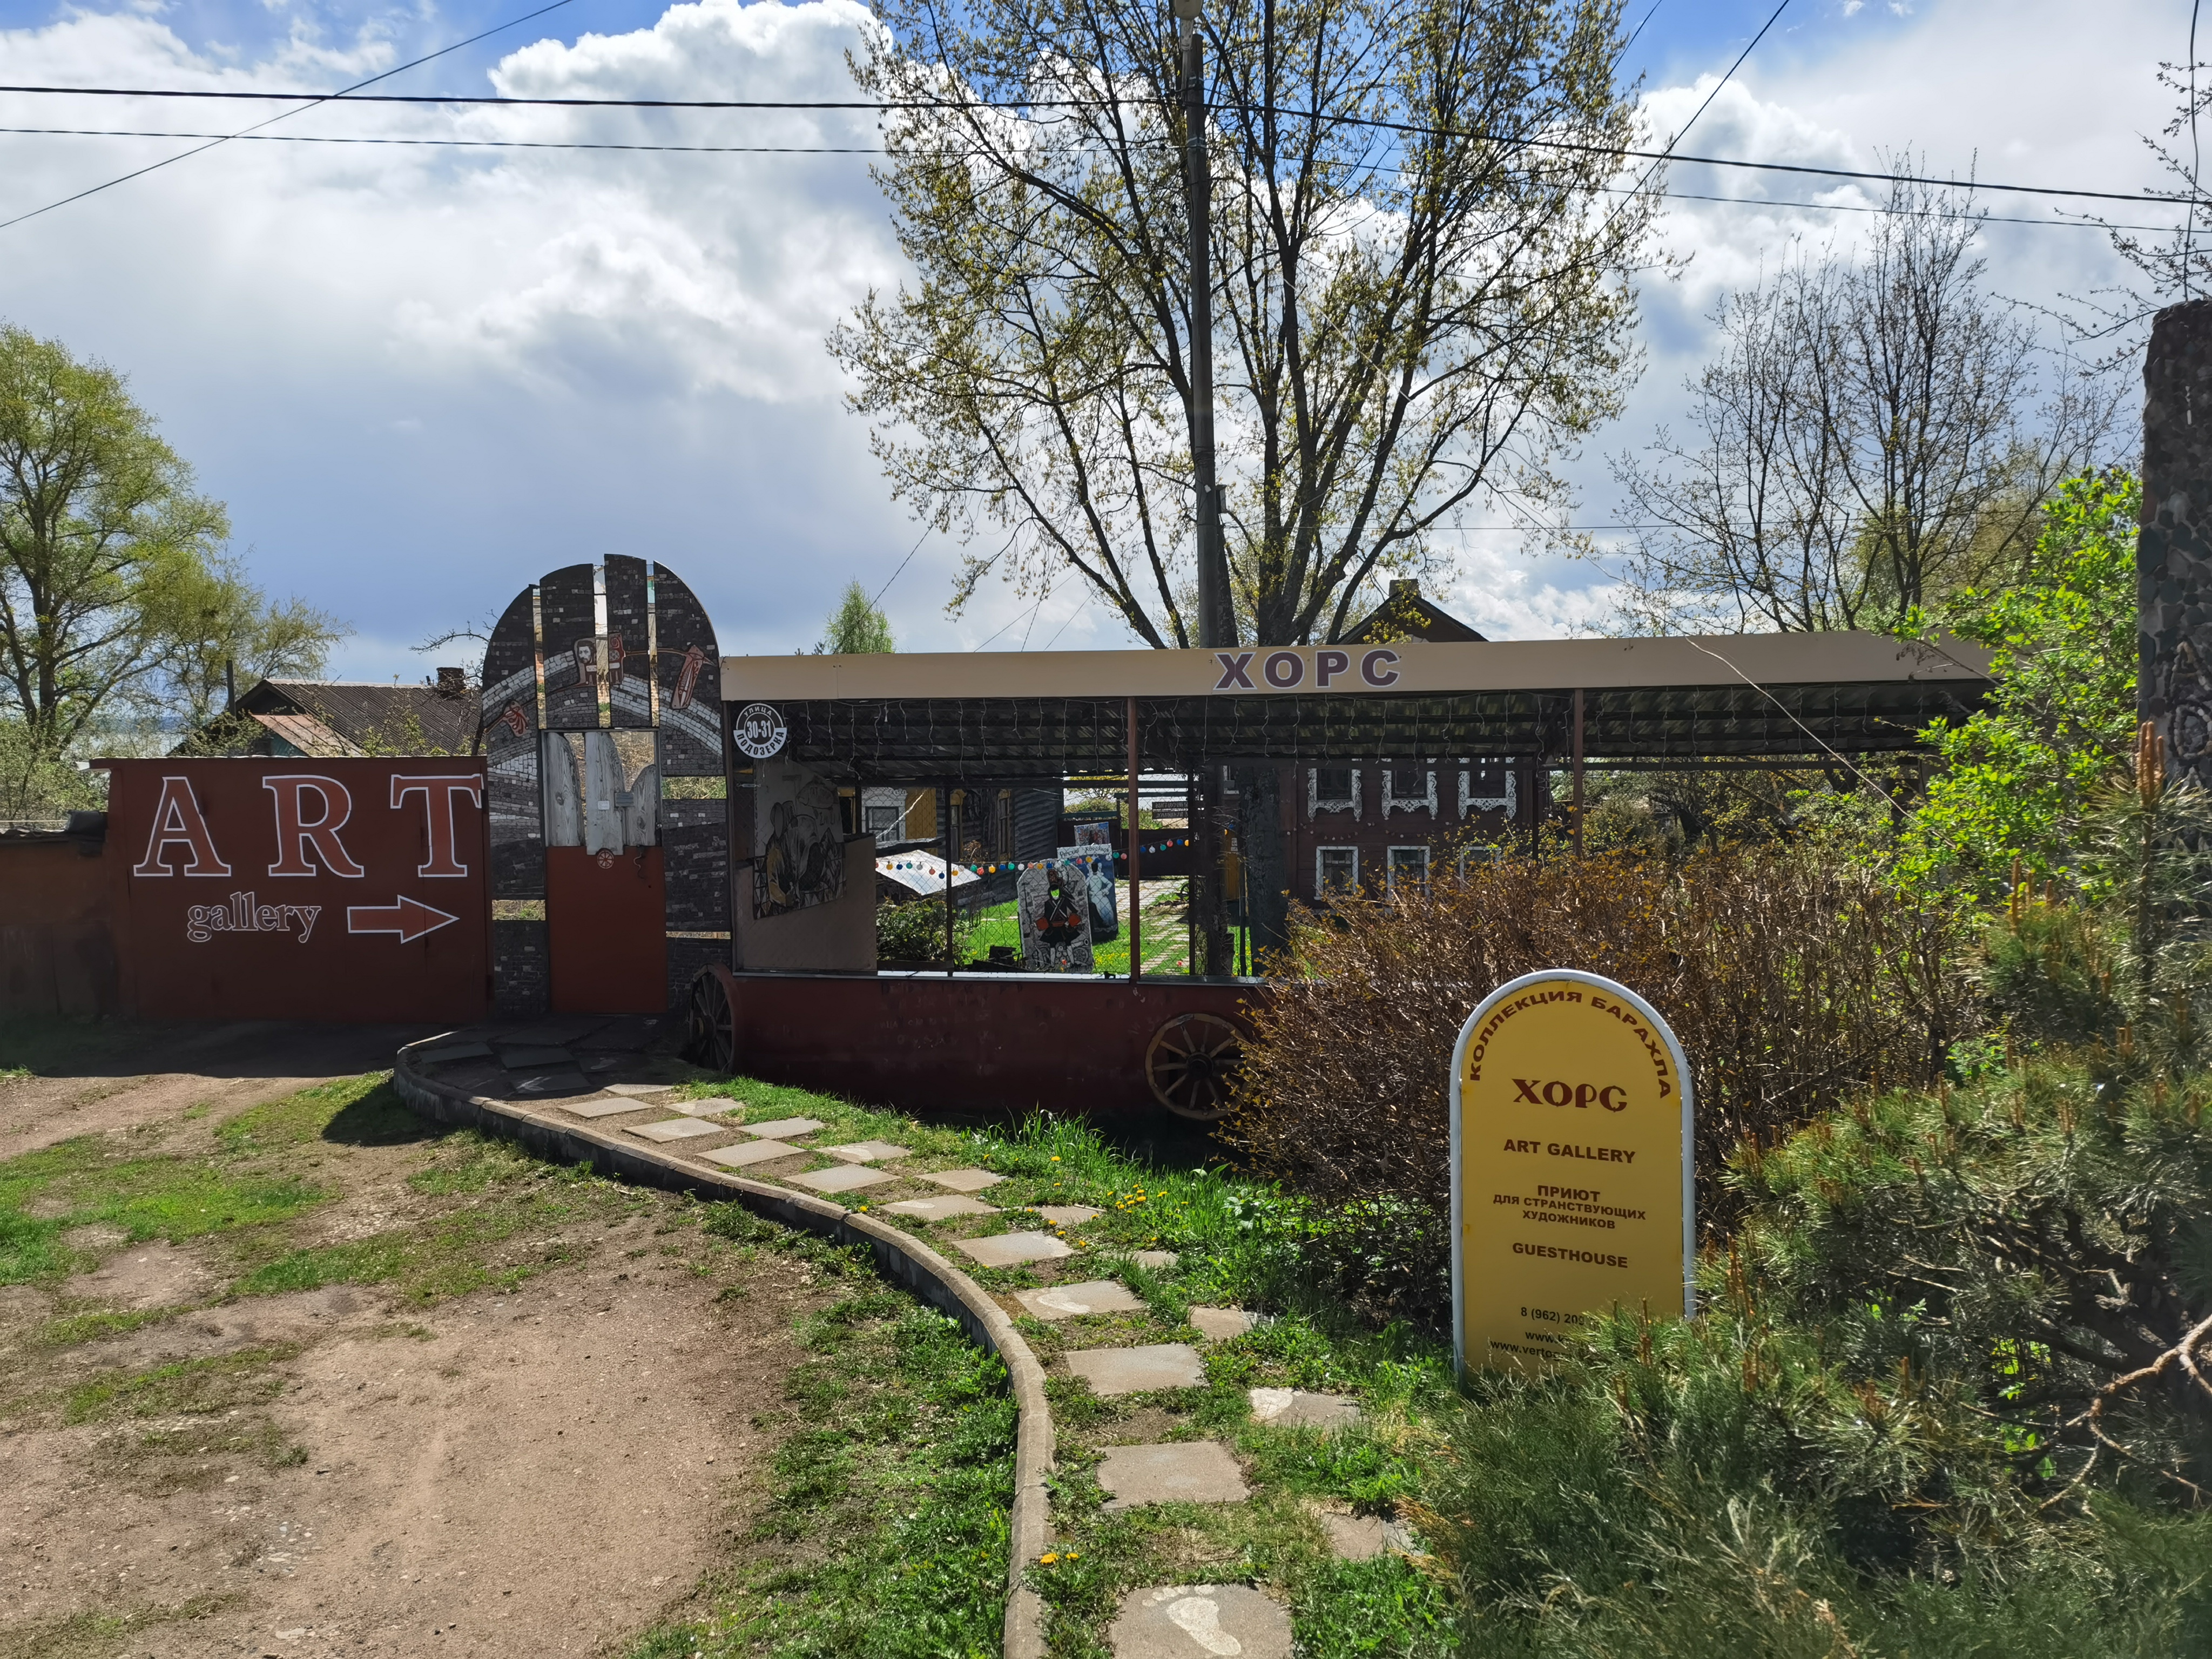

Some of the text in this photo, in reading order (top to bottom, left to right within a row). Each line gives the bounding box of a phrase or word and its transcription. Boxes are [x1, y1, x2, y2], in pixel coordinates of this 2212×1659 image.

[1212, 648, 1401, 690] ХОРС
[744, 706, 772, 717] УЛИЦА
[736, 731, 785, 756] ПОДОЗЕРКА
[132, 773, 485, 879] ART
[186, 891, 322, 943] gallery
[1469, 991, 1671, 1098] КОЛЛЕКЦИЯ БАРАХЛА
[1511, 1078, 1628, 1112] ХОРС
[1503, 1139, 1636, 1164] ART GALLERY
[1537, 1185, 1600, 1202] ПРИЮТ
[1493, 1194, 1646, 1220] ДЛЯ СТРАНСТВУЮЩИХ
[1522, 1210, 1615, 1229] ХУДОЖНИКОВ
[1512, 1242, 1628, 1269] GUESTHOUSE
[1521, 1306, 1527, 1317] 8
[1531, 1308, 1561, 1324] (962)
